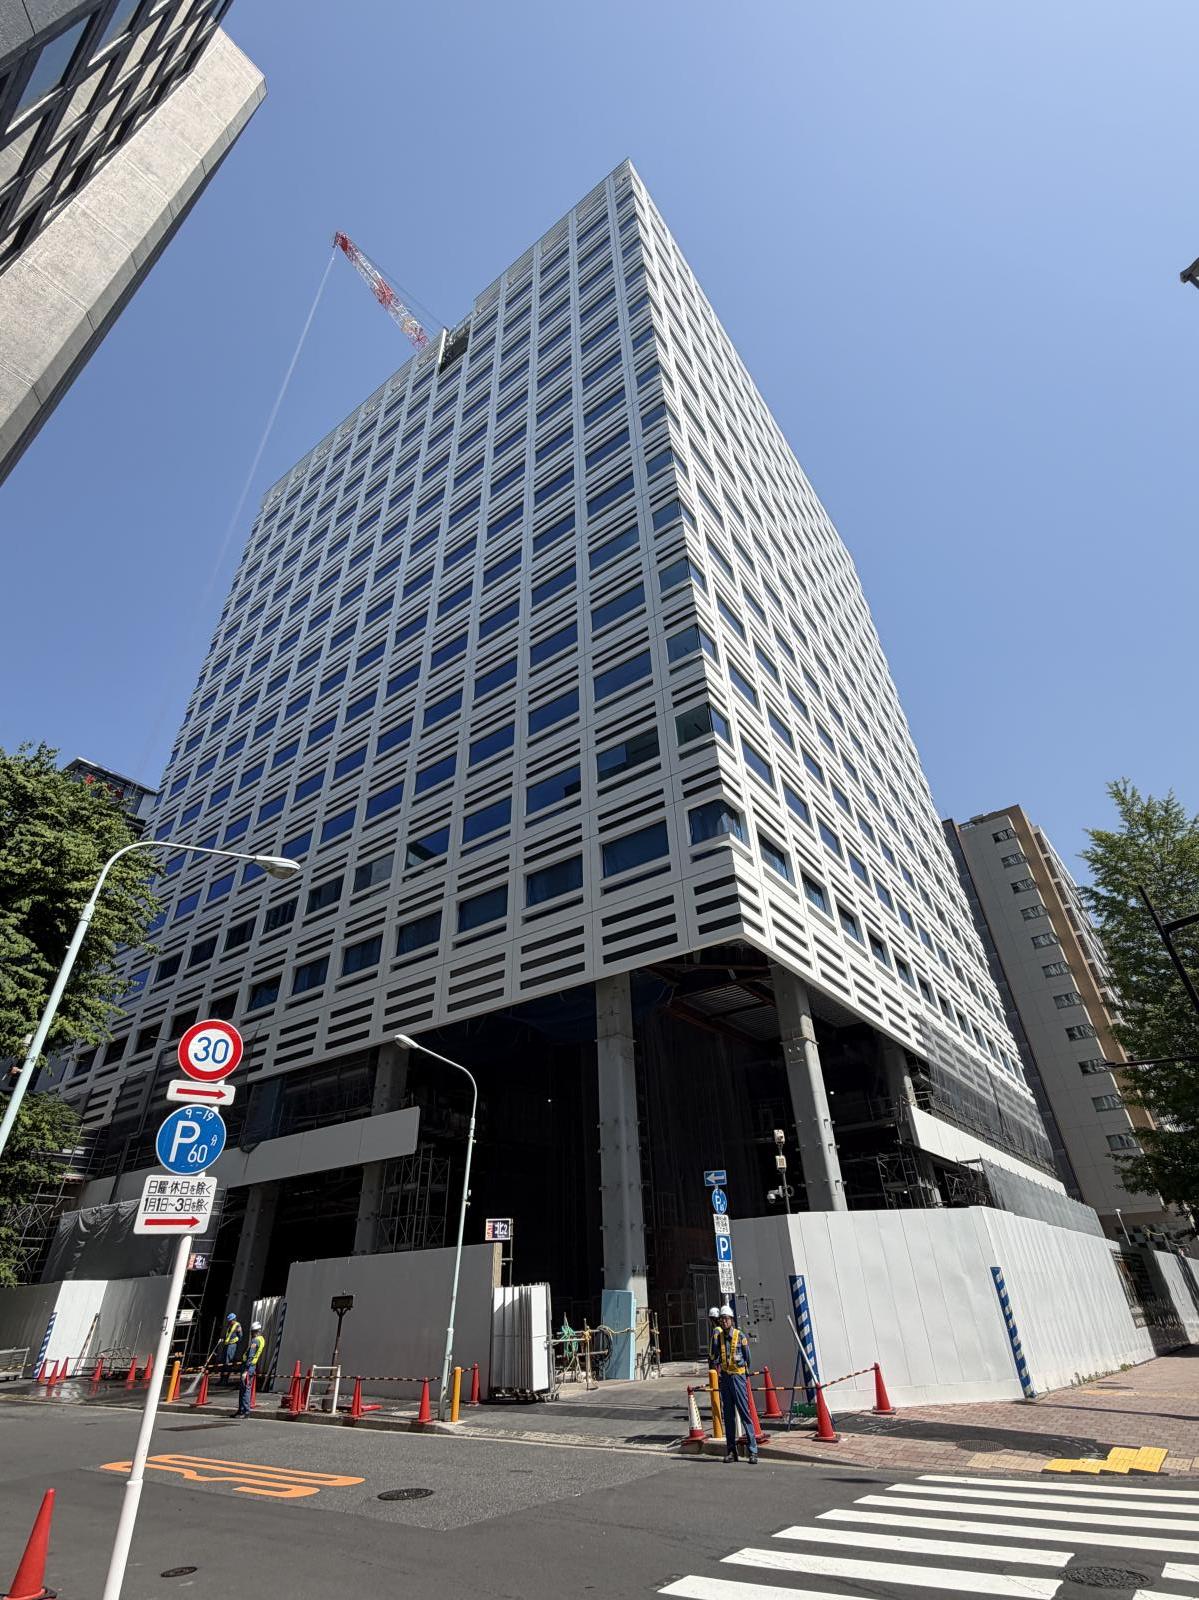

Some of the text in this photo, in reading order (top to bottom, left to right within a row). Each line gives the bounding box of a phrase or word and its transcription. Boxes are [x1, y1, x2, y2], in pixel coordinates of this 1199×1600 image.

[194, 1037, 230, 1064] 30
[168, 1120, 201, 1163] P
[187, 1144, 208, 1163] 60
[720, 1237, 728, 1258] P
